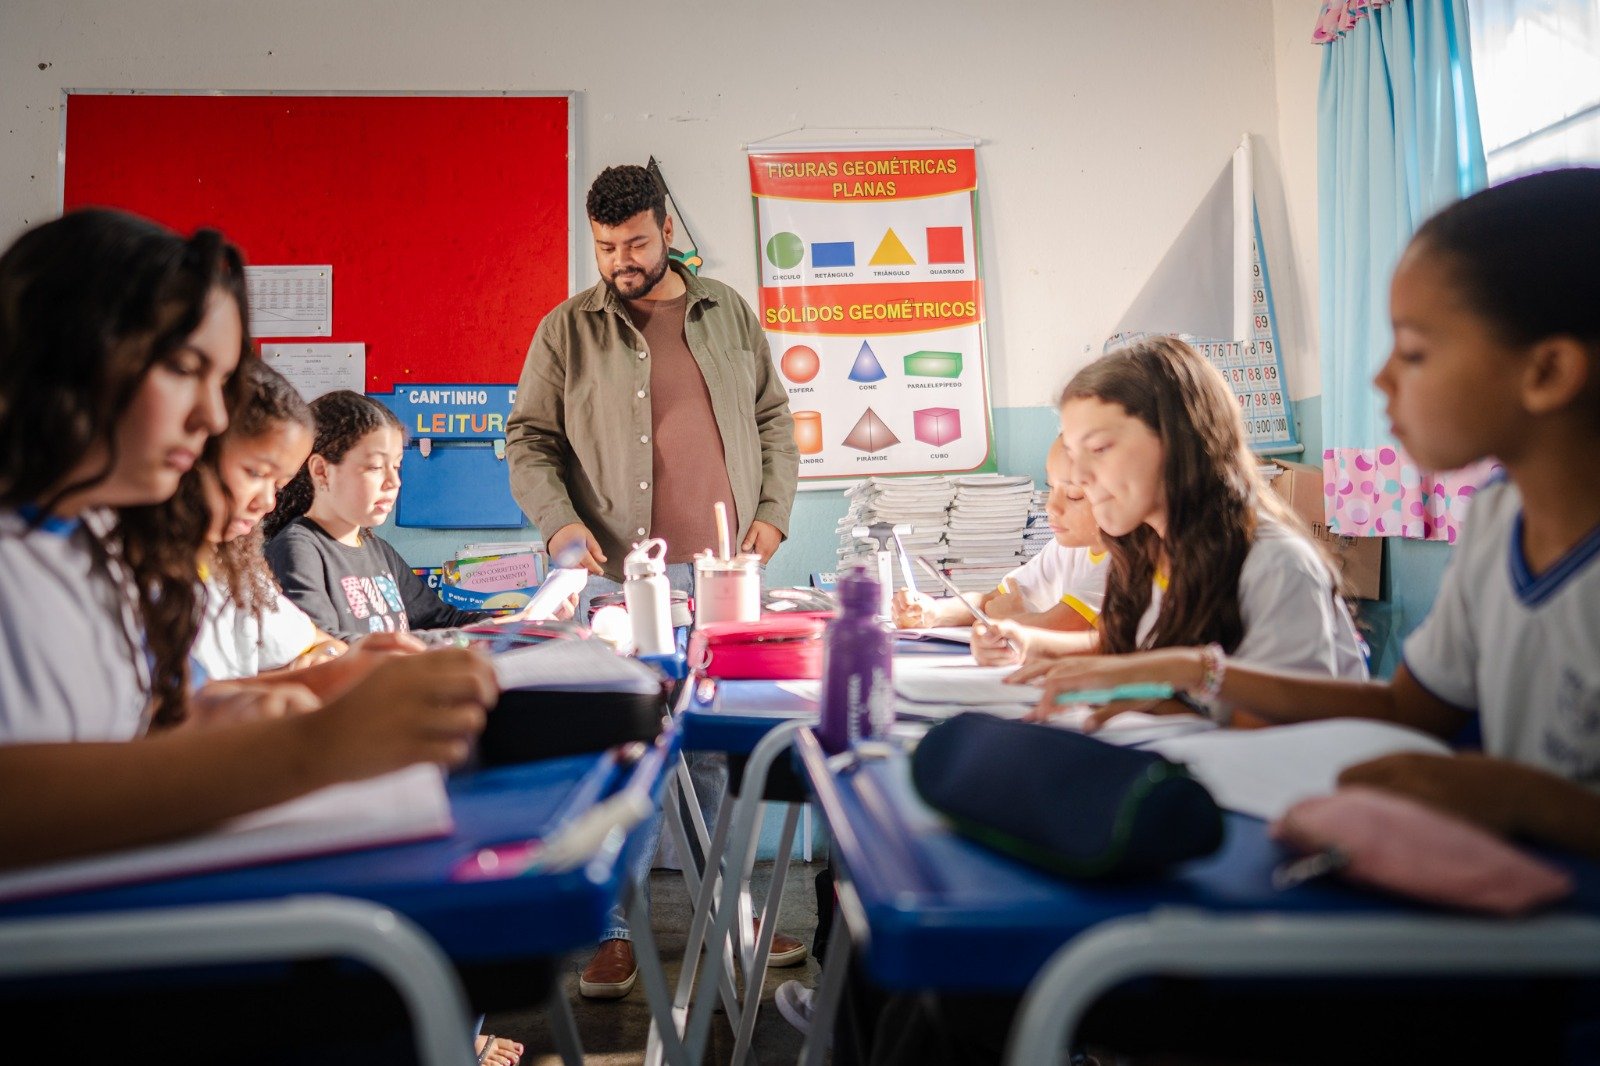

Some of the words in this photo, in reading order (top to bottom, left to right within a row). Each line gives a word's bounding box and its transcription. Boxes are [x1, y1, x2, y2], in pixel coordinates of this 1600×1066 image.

[768, 161, 839, 178] FIGURAS
[842, 156, 957, 176] GEOMÉTRICAS
[832, 181, 897, 198] PLANAS
[873, 269, 910, 277] TRIÂNGULO
[766, 304, 844, 324] SÓLIDOS
[848, 300, 977, 321] GEOMÉTRICOS
[1255, 315, 1268, 329] 69
[1212, 343, 1224, 357] 76
[1226, 343, 1239, 356] 77
[1259, 341, 1272, 354] 79
[1222, 370, 1229, 382] 6
[1232, 368, 1244, 382] 87
[1247, 367, 1261, 381] 88
[1264, 366, 1276, 380] 89
[907, 381, 963, 389] PARALELEPÍPEDO
[409, 390, 488, 405] CANTINHO
[1239, 394, 1251, 408] 97
[1254, 393, 1267, 407] 98
[1269, 392, 1281, 405] 99
[417, 413, 508, 433] LEITUR
[1256, 419, 1271, 433] 900
[1273, 418, 1287, 431] 1000
[448, 593, 467, 602] Peter
